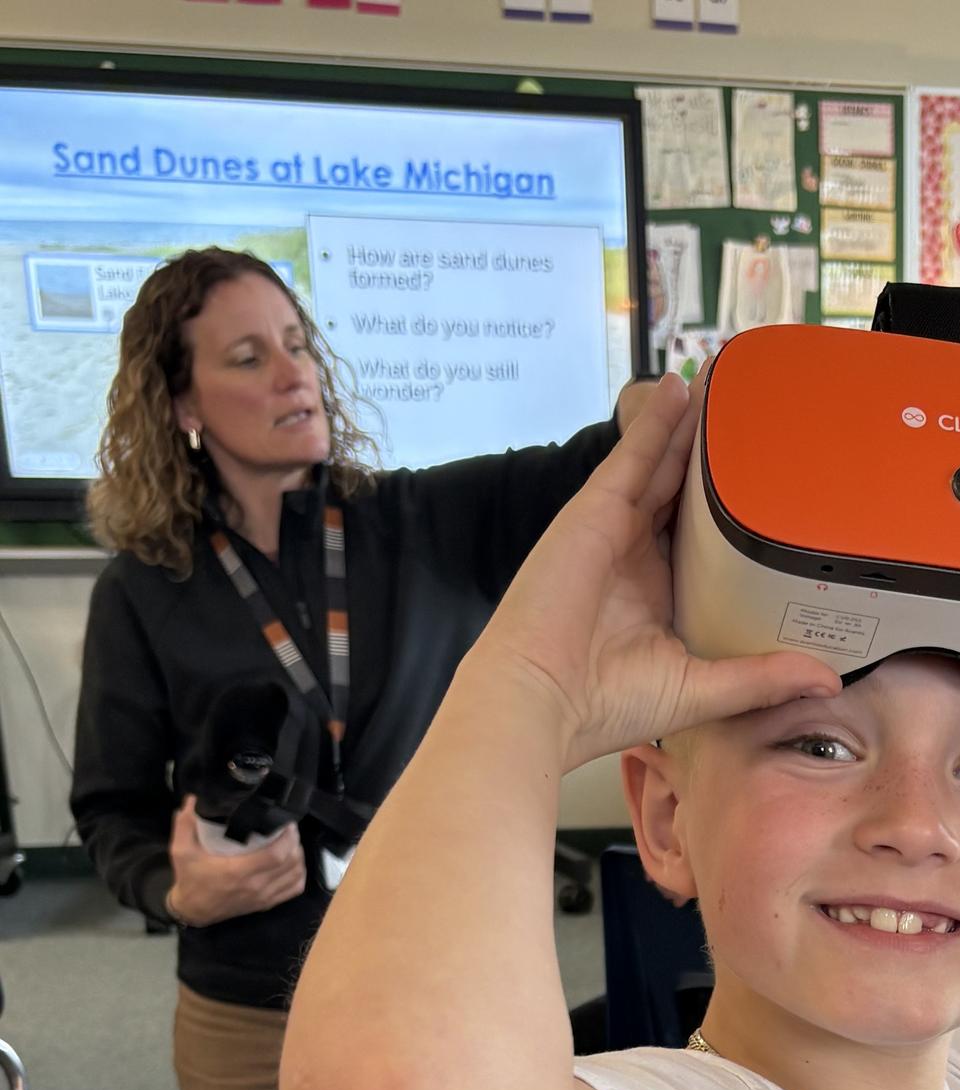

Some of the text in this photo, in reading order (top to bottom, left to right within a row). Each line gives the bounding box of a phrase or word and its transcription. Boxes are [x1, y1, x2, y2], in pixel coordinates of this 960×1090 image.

[53, 142, 556, 198] Sand Dunes at Lake Michigan
[348, 246, 554, 272] How are sand dunes
[350, 270, 433, 291] formed?
[352, 314, 555, 341] What do you notice?
[359, 360, 519, 386] What do you still
[360, 383, 444, 402] wonder?
